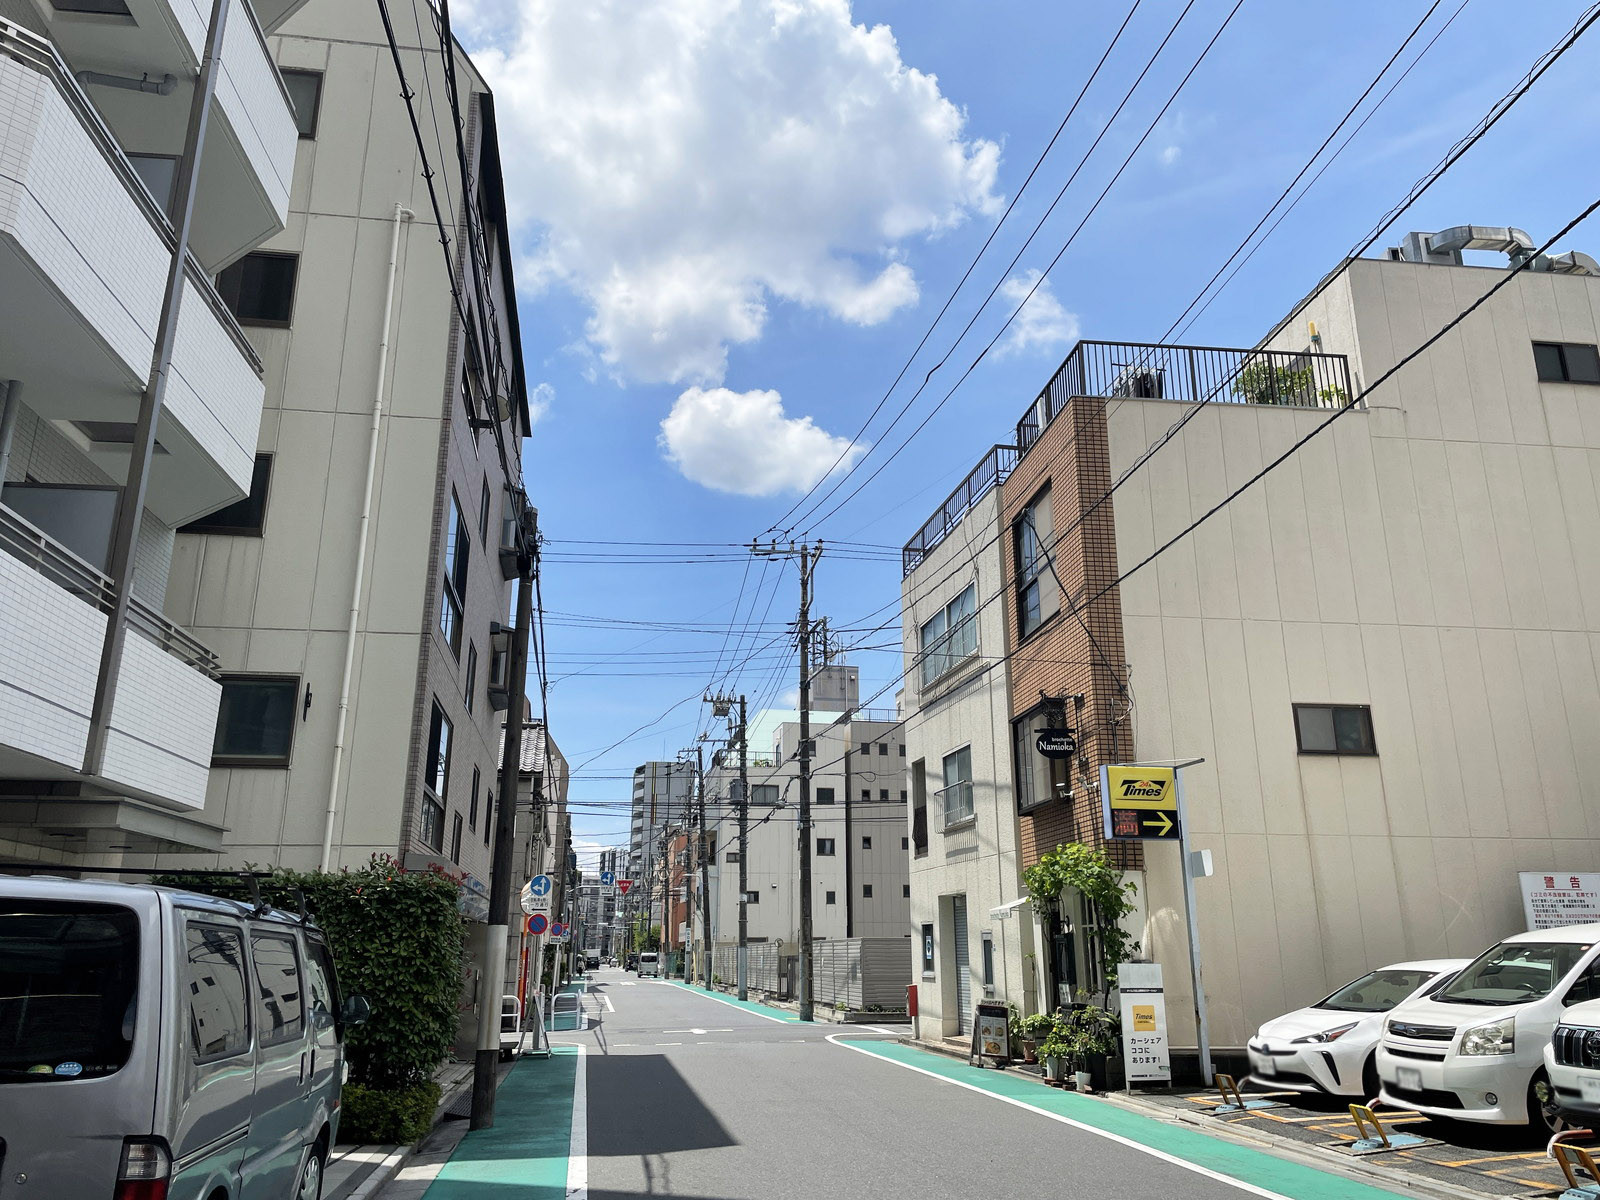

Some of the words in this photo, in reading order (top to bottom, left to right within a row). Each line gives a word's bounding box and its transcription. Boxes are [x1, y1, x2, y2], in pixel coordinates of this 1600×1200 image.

[1039, 741, 1074, 751] Namioka
[1120, 780, 1167, 797] Times
[1130, 1037, 1162, 1045] カーシェア
